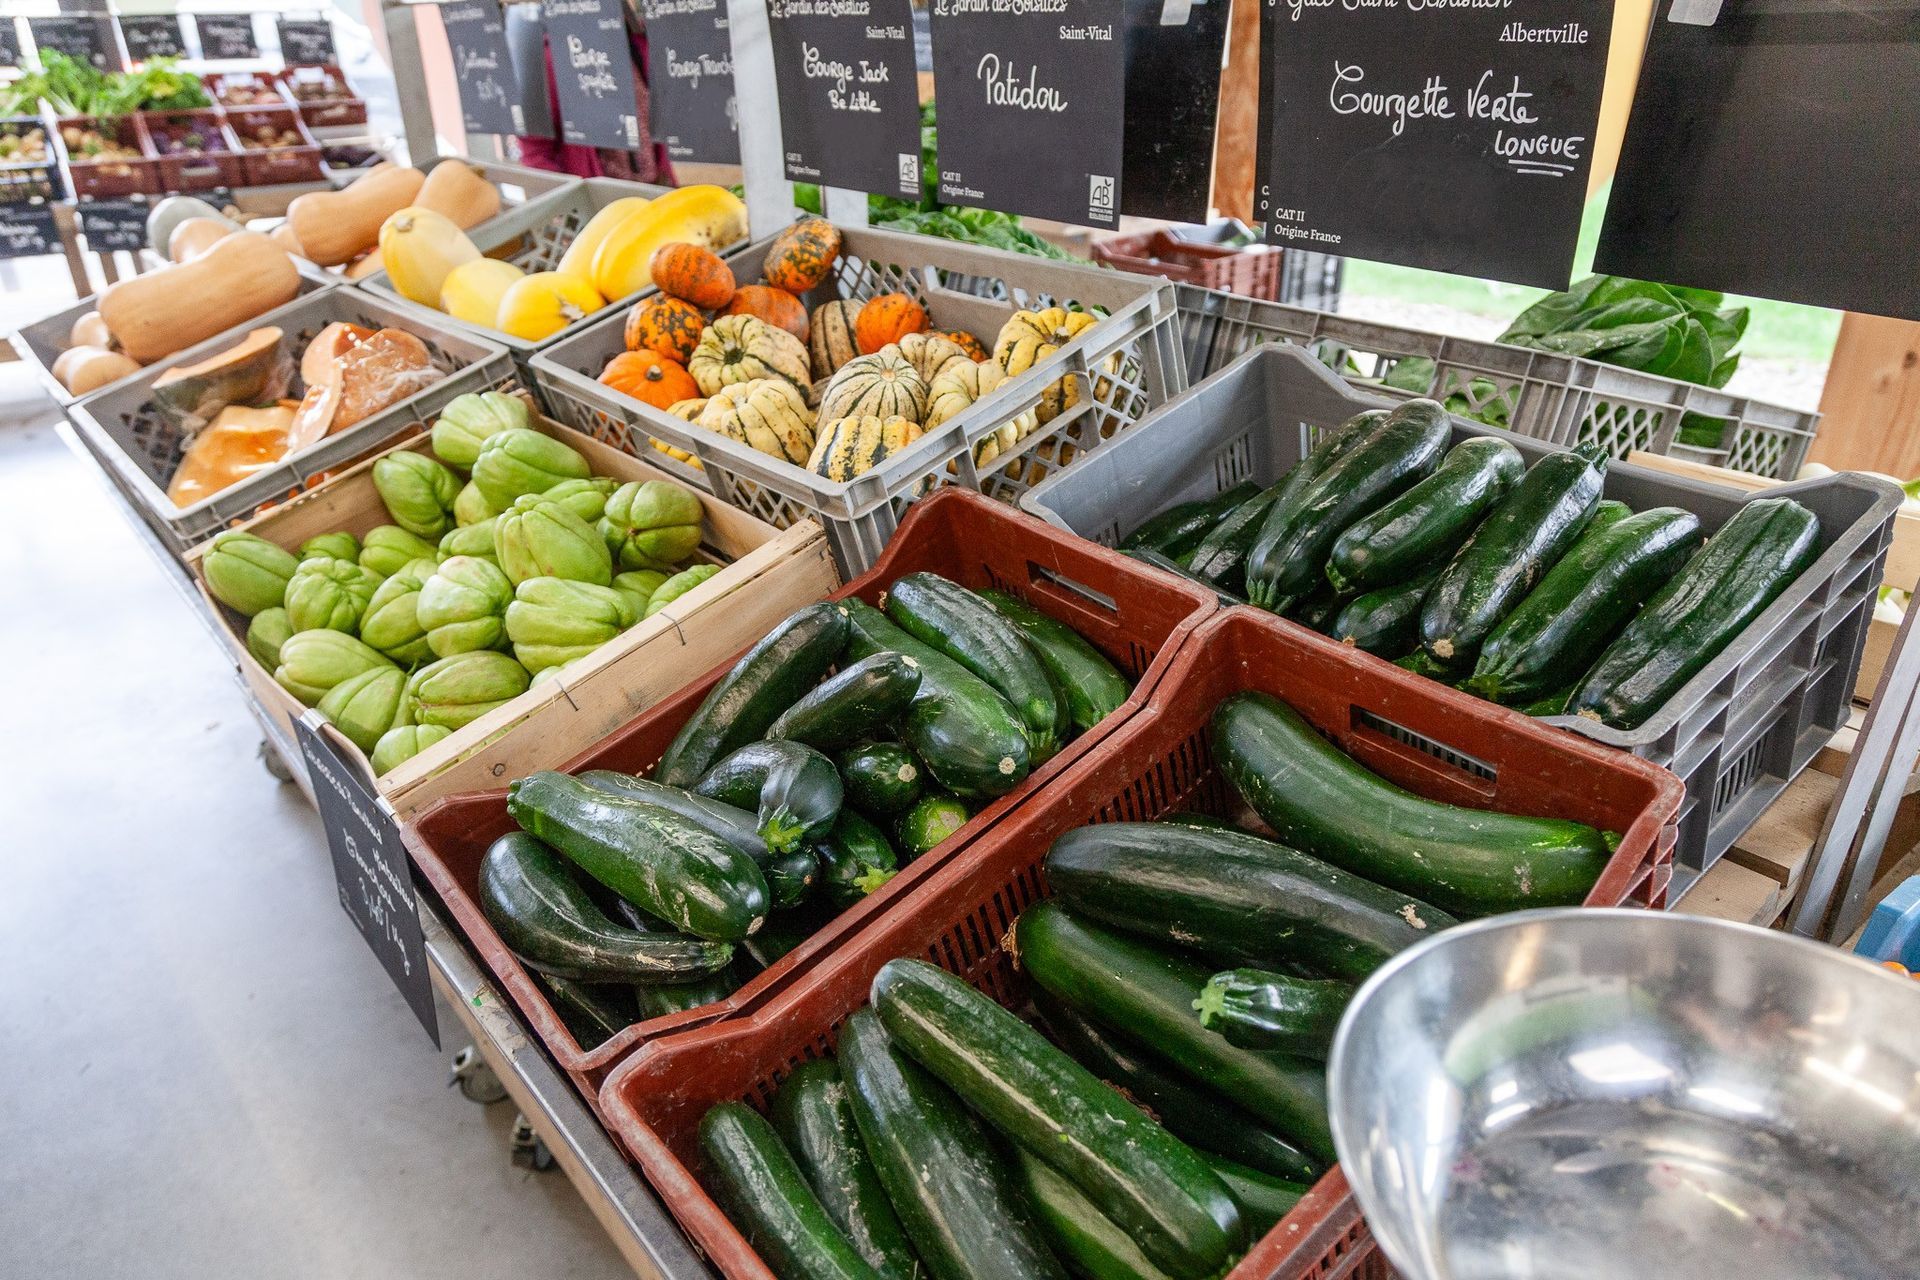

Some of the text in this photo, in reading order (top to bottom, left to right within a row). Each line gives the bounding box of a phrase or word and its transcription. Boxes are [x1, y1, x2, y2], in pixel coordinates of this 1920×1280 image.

[865, 25, 905, 39] Saint-Vital
[1059, 25, 1112, 40] Saint-Vital
[1499, 22, 1588, 44] Albertville
[802, 41, 889, 93] Courge Jack
[977, 52, 1068, 112] Patidou
[1330, 60, 1455, 136] Courgette
[1494, 129, 1585, 159] LONGUE
[1091, 184, 1110, 206] AB
[1275, 208, 1305, 222] CAT II
[1274, 223, 1342, 244] Origine France
